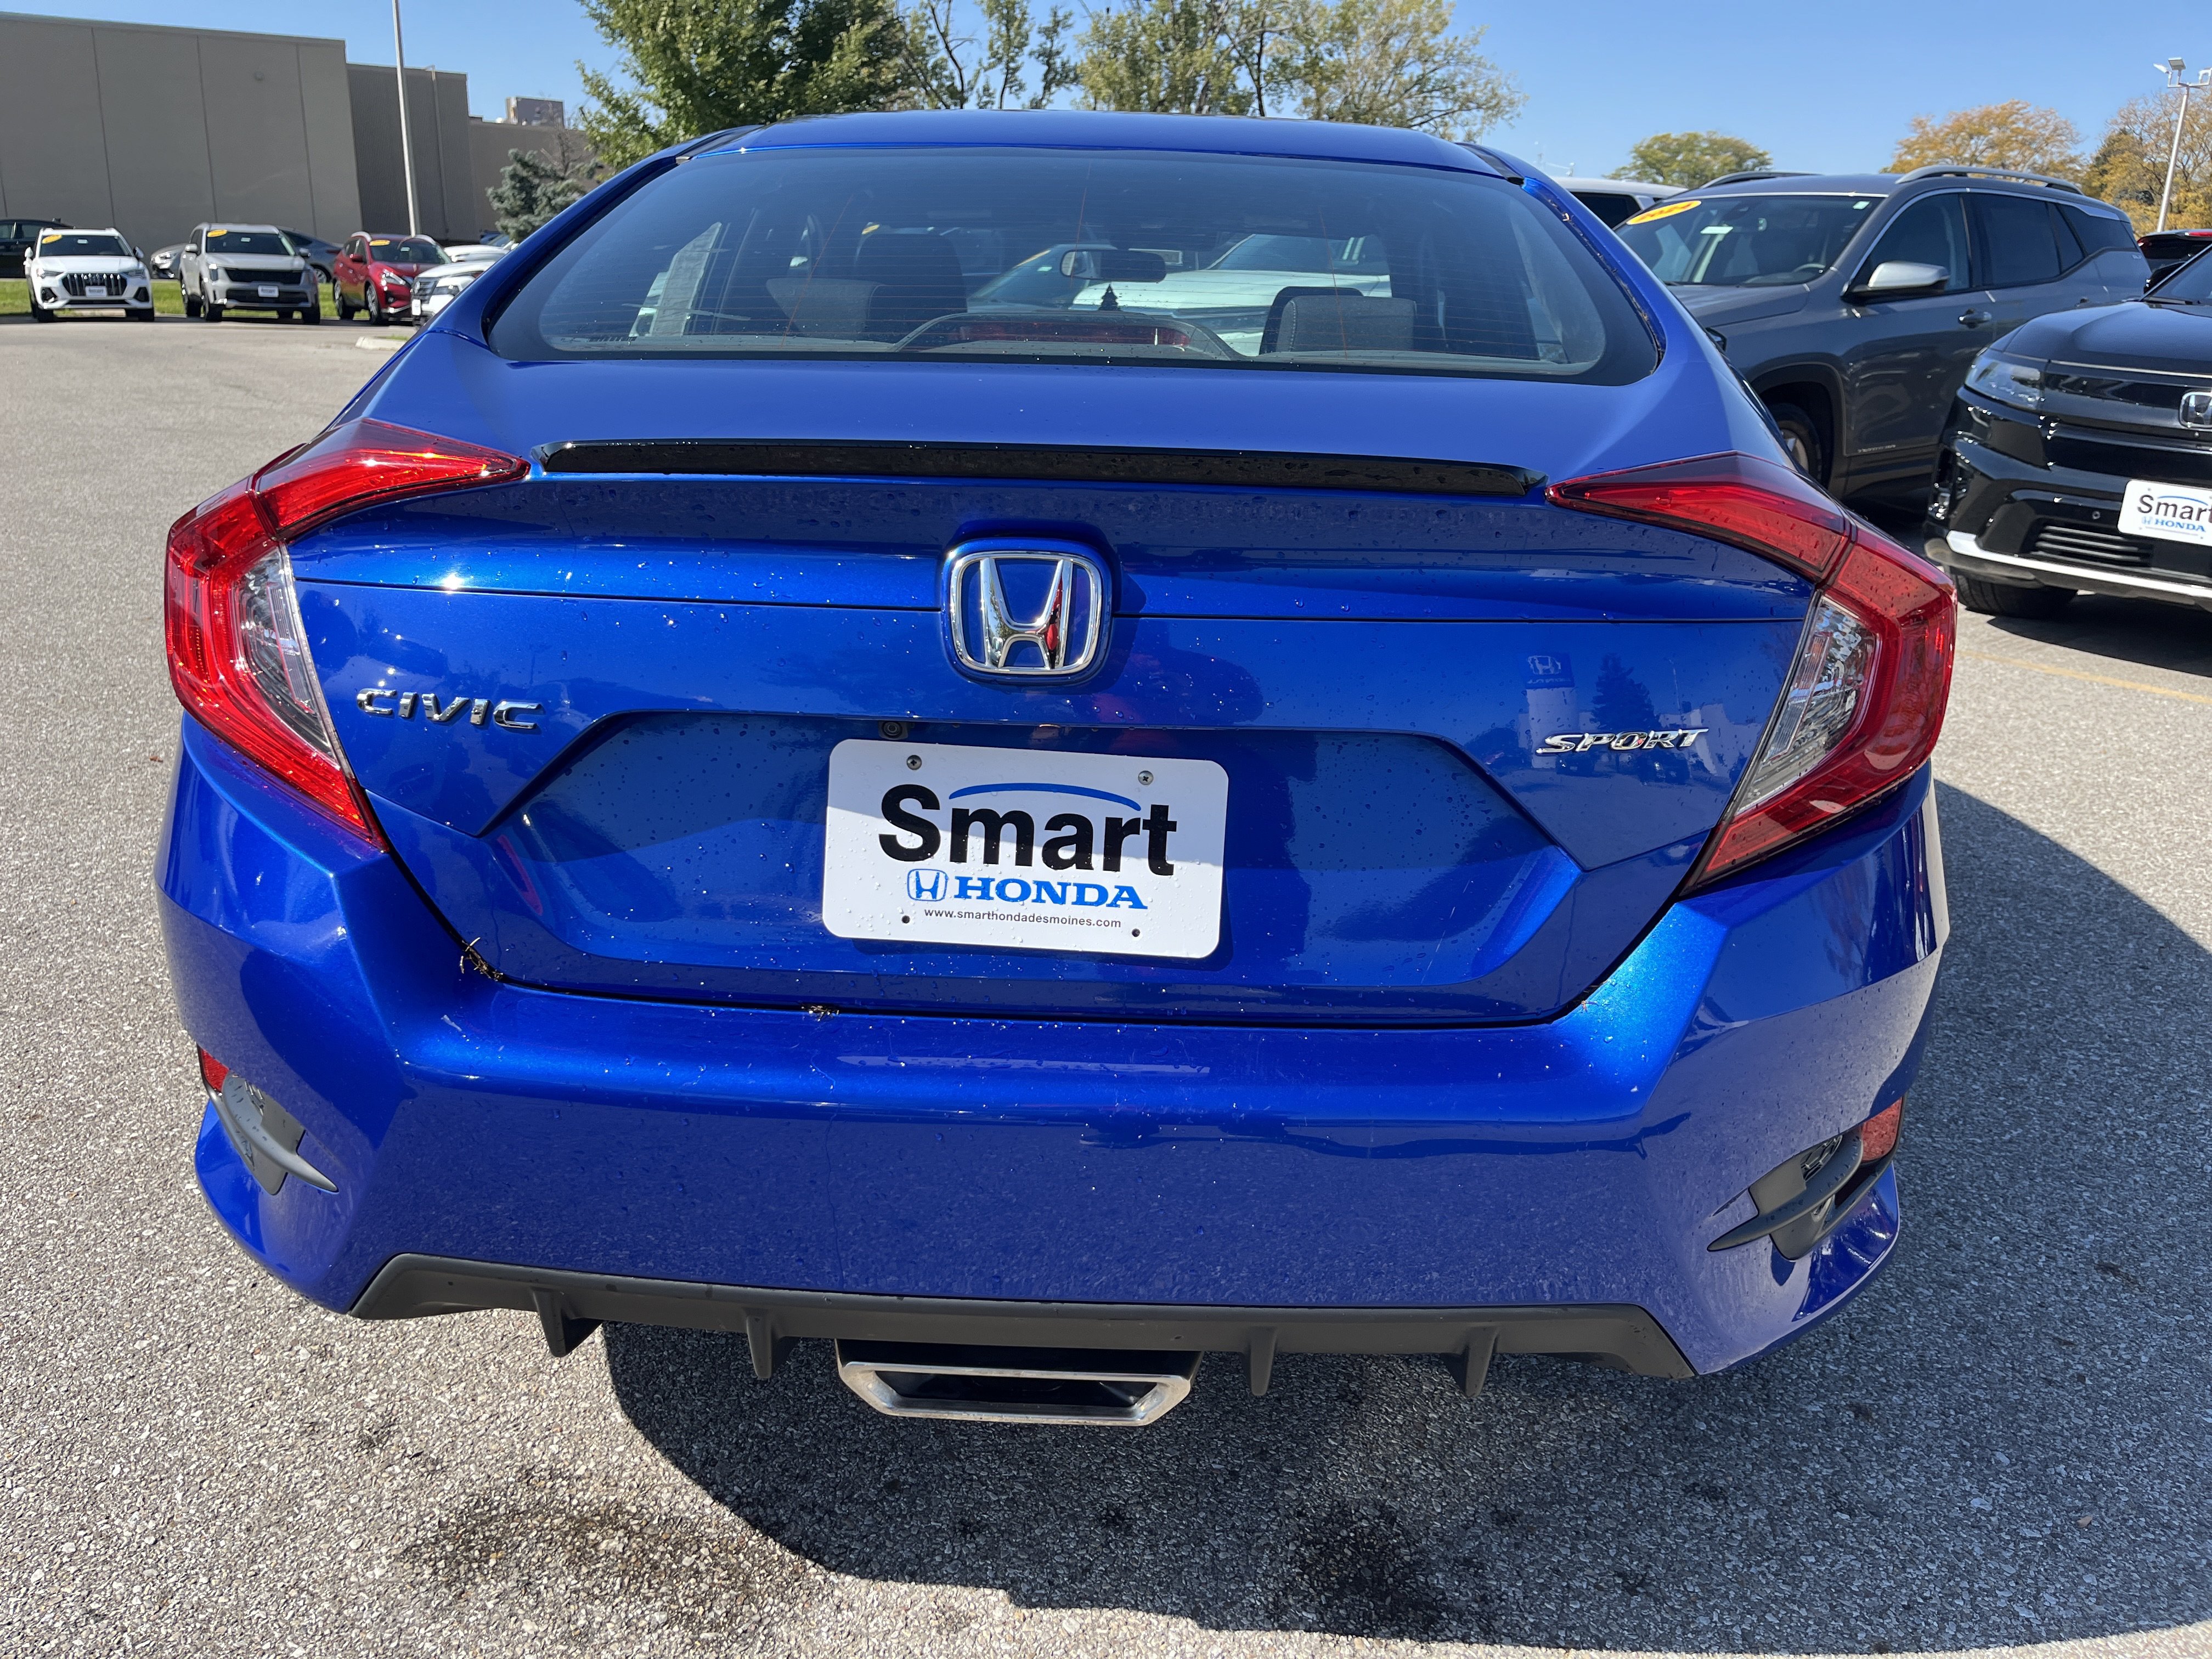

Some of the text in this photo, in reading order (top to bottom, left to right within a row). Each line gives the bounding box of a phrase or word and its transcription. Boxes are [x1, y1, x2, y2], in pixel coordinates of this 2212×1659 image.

[2154, 518, 2206, 532] HONDA
[357, 688, 542, 729] CIVIC
[1536, 728, 1709, 754] SPORT
[879, 784, 1177, 876] Smart
[954, 876, 1148, 910] HONDA
[924, 909, 1122, 928] www.smarthondadesmoines.com
